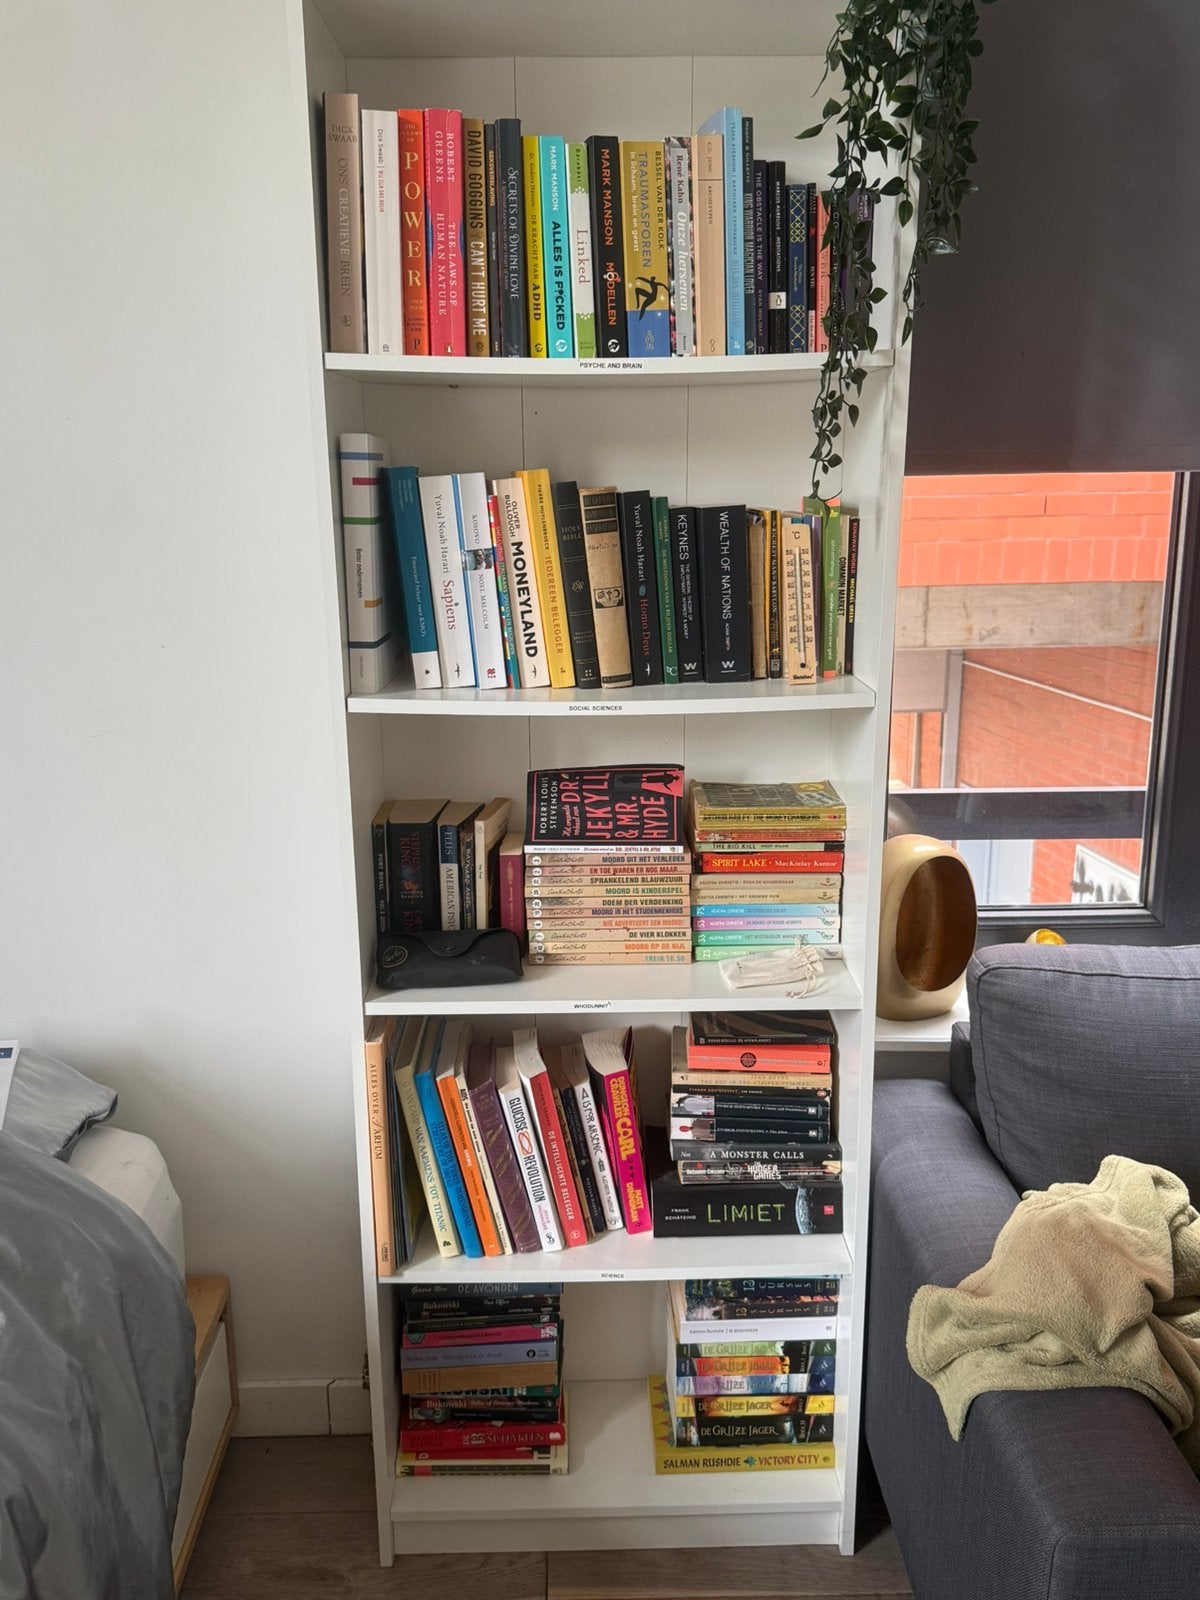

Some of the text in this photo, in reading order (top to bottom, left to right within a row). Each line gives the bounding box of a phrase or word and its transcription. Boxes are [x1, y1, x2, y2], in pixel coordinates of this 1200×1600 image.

[328, 133, 358, 144] SWAAB
[331, 124, 354, 133] DICK
[435, 130, 444, 183] GREENE
[446, 132, 456, 183] ROBERT
[601, 148, 612, 185] MARK
[676, 155, 685, 177] René
[550, 173, 559, 211] MANSON
[639, 151, 652, 268] TRAUMASPOREN
[338, 158, 352, 296] ONS CREATIEVE BREIN
[404, 151, 423, 287] POWER
[467, 130, 486, 335] DAVID GOGGINS CAN'T HURT ME
[507, 166, 520, 300] SECRETS OF DIVINE LOVE
[603, 190, 613, 246] MANSON
[632, 218, 638, 228] en
[676, 211, 687, 247] Onze
[552, 221, 562, 260] ALLES
[576, 229, 590, 284] Linked
[631, 230, 640, 252] geest
[436, 212, 448, 316] HUMAN NATURE
[448, 253, 457, 286] LAWS
[554, 265, 563, 277] IS
[678, 251, 689, 311] hersenen
[450, 290, 457, 306] OF
[533, 283, 541, 320] ADHD
[504, 494, 516, 537] BULLOUGH
[512, 500, 520, 530] OLIVER
[677, 514, 689, 560] KEYNES
[435, 495, 460, 630] Yuval Noah Harari Sapiens
[472, 514, 480, 544] KOSOVO
[480, 595, 490, 630] MALCOLM
[633, 504, 650, 656] Yuval Noah Harari Homo Deus
[719, 511, 732, 619] WEALTH OF NATIONS
[511, 541, 538, 658] MONEYLAND
[544, 556, 564, 655] IEDEREEN BELEGGER
[837, 557, 846, 616] COMMON MARKET
[560, 776, 580, 803] DR.
[582, 772, 612, 839] JEKYLL
[615, 796, 640, 839] & MR.
[641, 797, 668, 838] HYDE
[400, 837, 411, 867] KING
[444, 832, 455, 910] ELLIS AMERICAN
[712, 859, 739, 867] SPIRIT
[609, 1079, 622, 1118] CRAWLER
[618, 1076, 630, 1116] DUNGEON
[509, 1097, 546, 1203] GLUCOSE REVOLUTION
[615, 1118, 635, 1160] CARL
[548, 1130, 575, 1220] DE INTELLIGENTE BELEGGER
[748, 1165, 778, 1173] HUNGER
[753, 1172, 781, 1180] GAMES
[626, 1182, 639, 1222] DINNIMAN
[634, 1189, 644, 1209] MATT
[707, 1204, 785, 1223] LIMIET
[458, 1283, 518, 1293] DE AVONDEN
[743, 1280, 755, 1291] 13
[736, 1308, 747, 1316] 13
[427, 1400, 467, 1409] Bukowski
[701, 1425, 779, 1436] DE GRIJZE JAGER
[664, 1455, 819, 1468] SALMAN RUSHDIE VICTORY CITY
